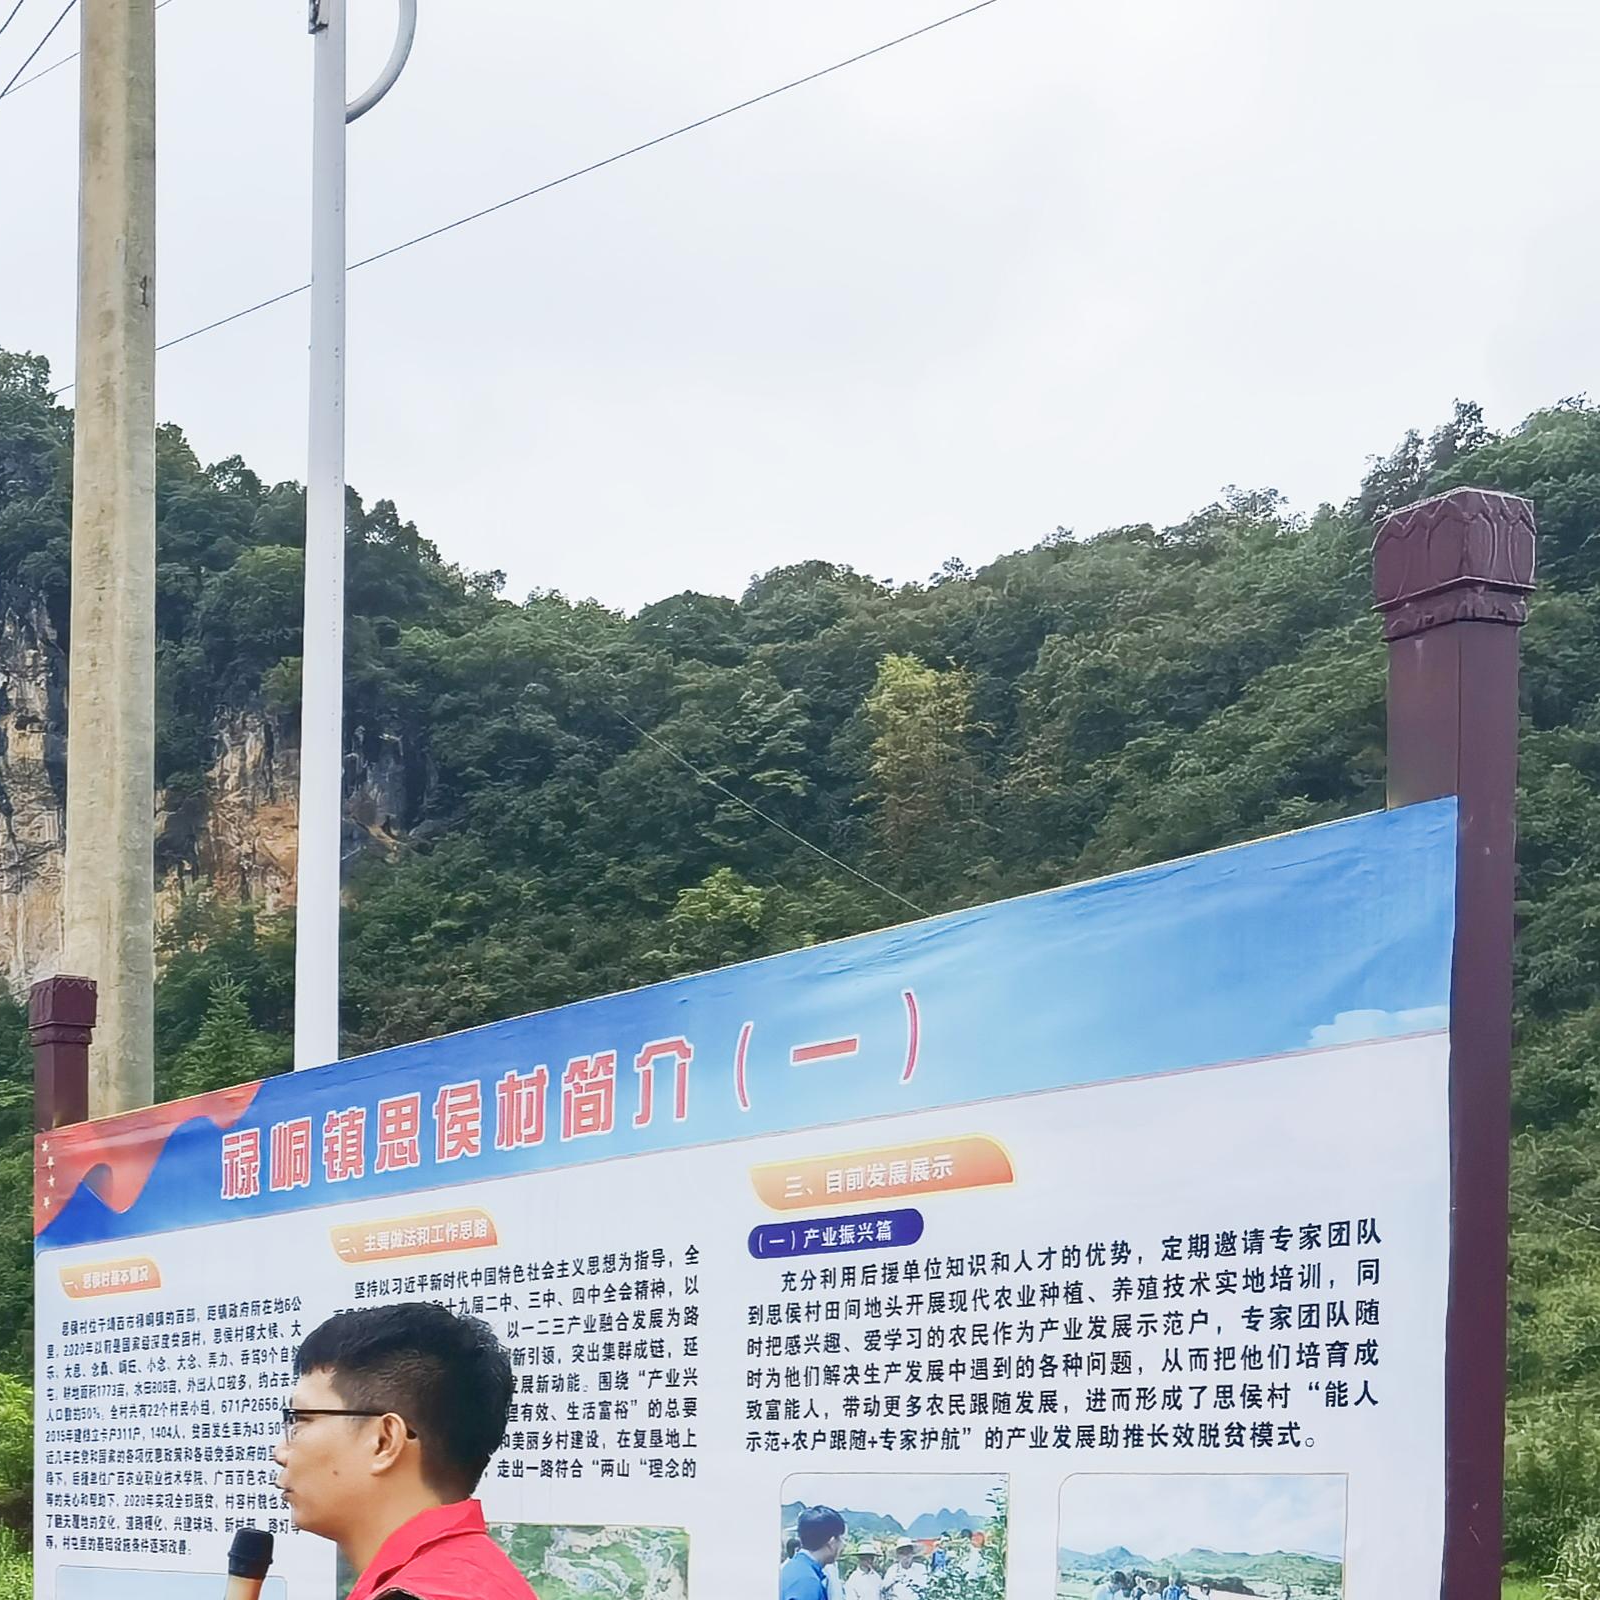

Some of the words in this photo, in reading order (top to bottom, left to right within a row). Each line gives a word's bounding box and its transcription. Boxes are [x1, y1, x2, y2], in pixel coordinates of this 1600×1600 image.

[784, 1154, 953, 1198] 三、目前发展展示
[338, 1218, 487, 1255] 二、主要做法和工作思路
[781, 1218, 1382, 1293] 充分利用后援单位知识和人才的优势，定期邀请专家团队
[354, 1244, 700, 1299] 坚持以习近平新时代中国特色社会主义思想为指导，全
[748, 1258, 1380, 1326] 到思侯村田间地头开展现代农业种植、养殖技术实地培训，同
[747, 1298, 1380, 1358] 时把感兴趣、爱学习的农民作为产业发展示范户，专家团队随
[746, 1338, 1380, 1389] 时为他们解决生产发展中遇到的各种问题，从而把他们培育成
[746, 1380, 1379, 1421] 致富能人，带动更多农民跟随发展，进而形成了思侯村“能人
[746, 1420, 1315, 1452] 示范+农户跟随+专家护航”的产业发展助推长效脱贫模式。
